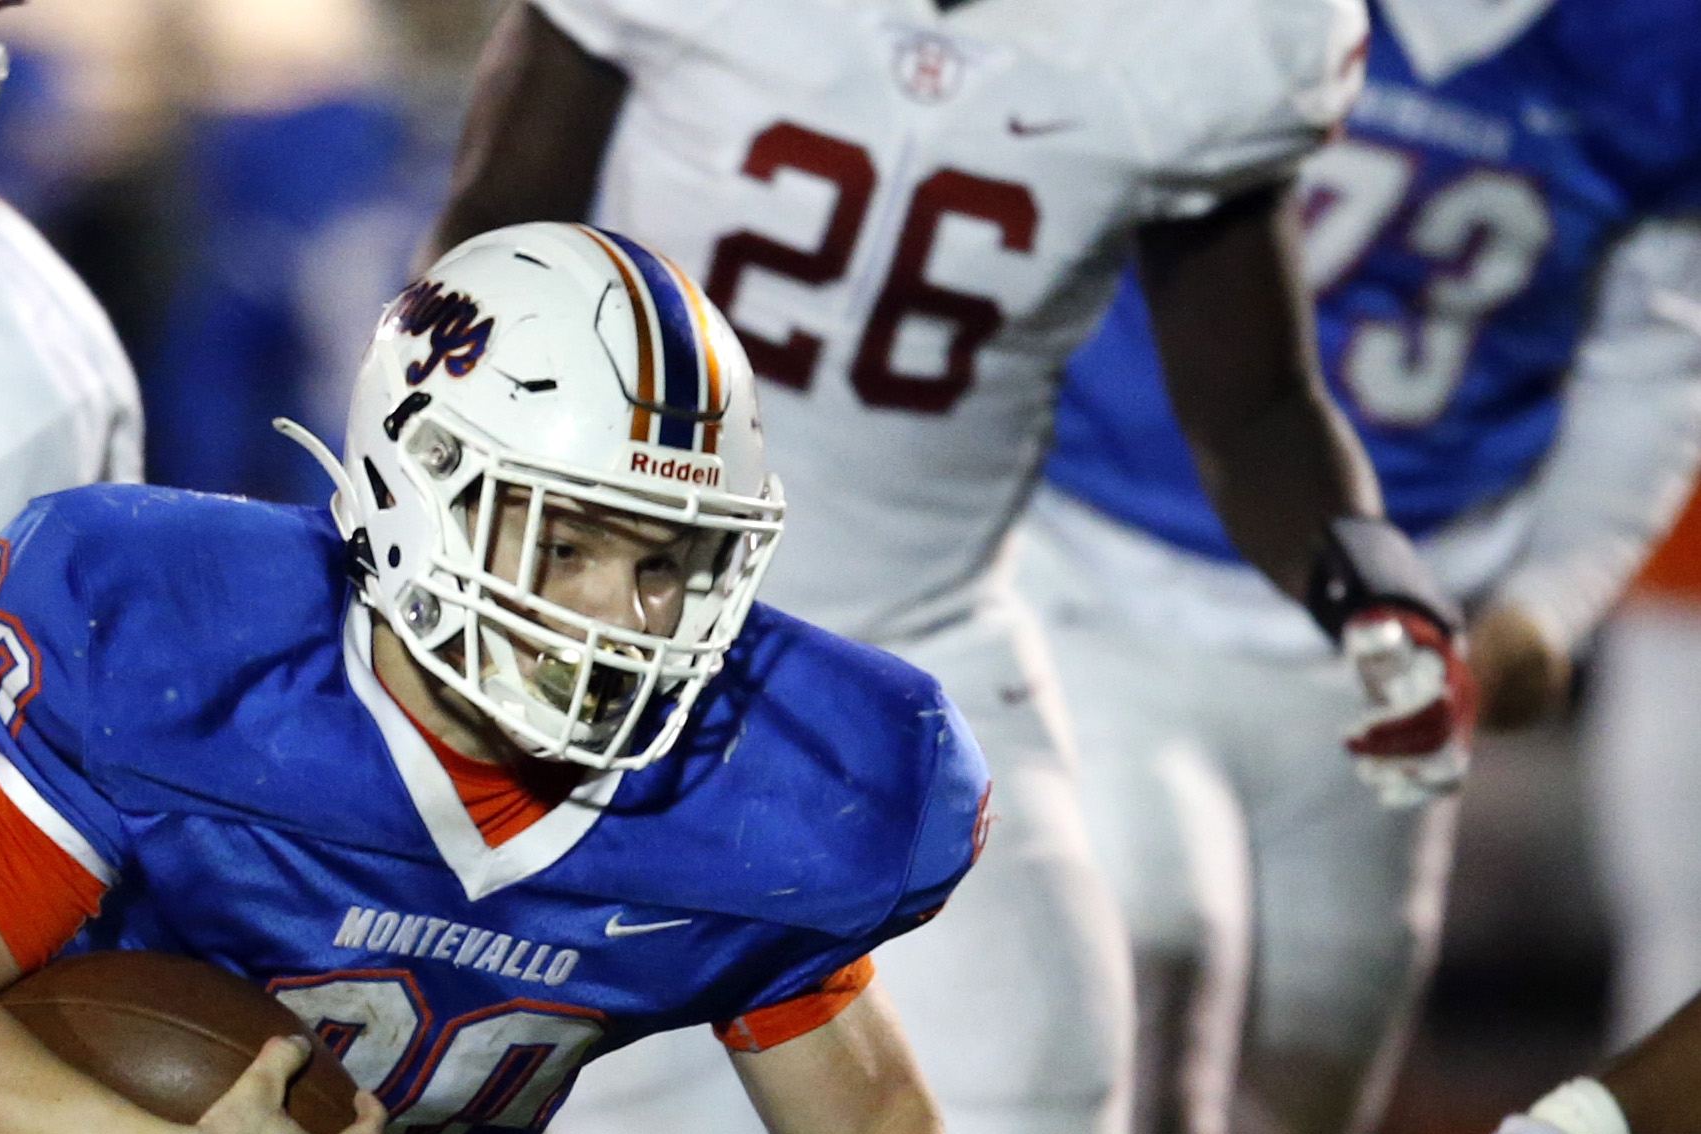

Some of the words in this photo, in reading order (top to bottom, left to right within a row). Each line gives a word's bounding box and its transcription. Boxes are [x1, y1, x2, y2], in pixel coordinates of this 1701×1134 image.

[701, 121, 1038, 416] 26
[631, 451, 720, 487] Riddell
[333, 905, 581, 987] MONTEVALLO
